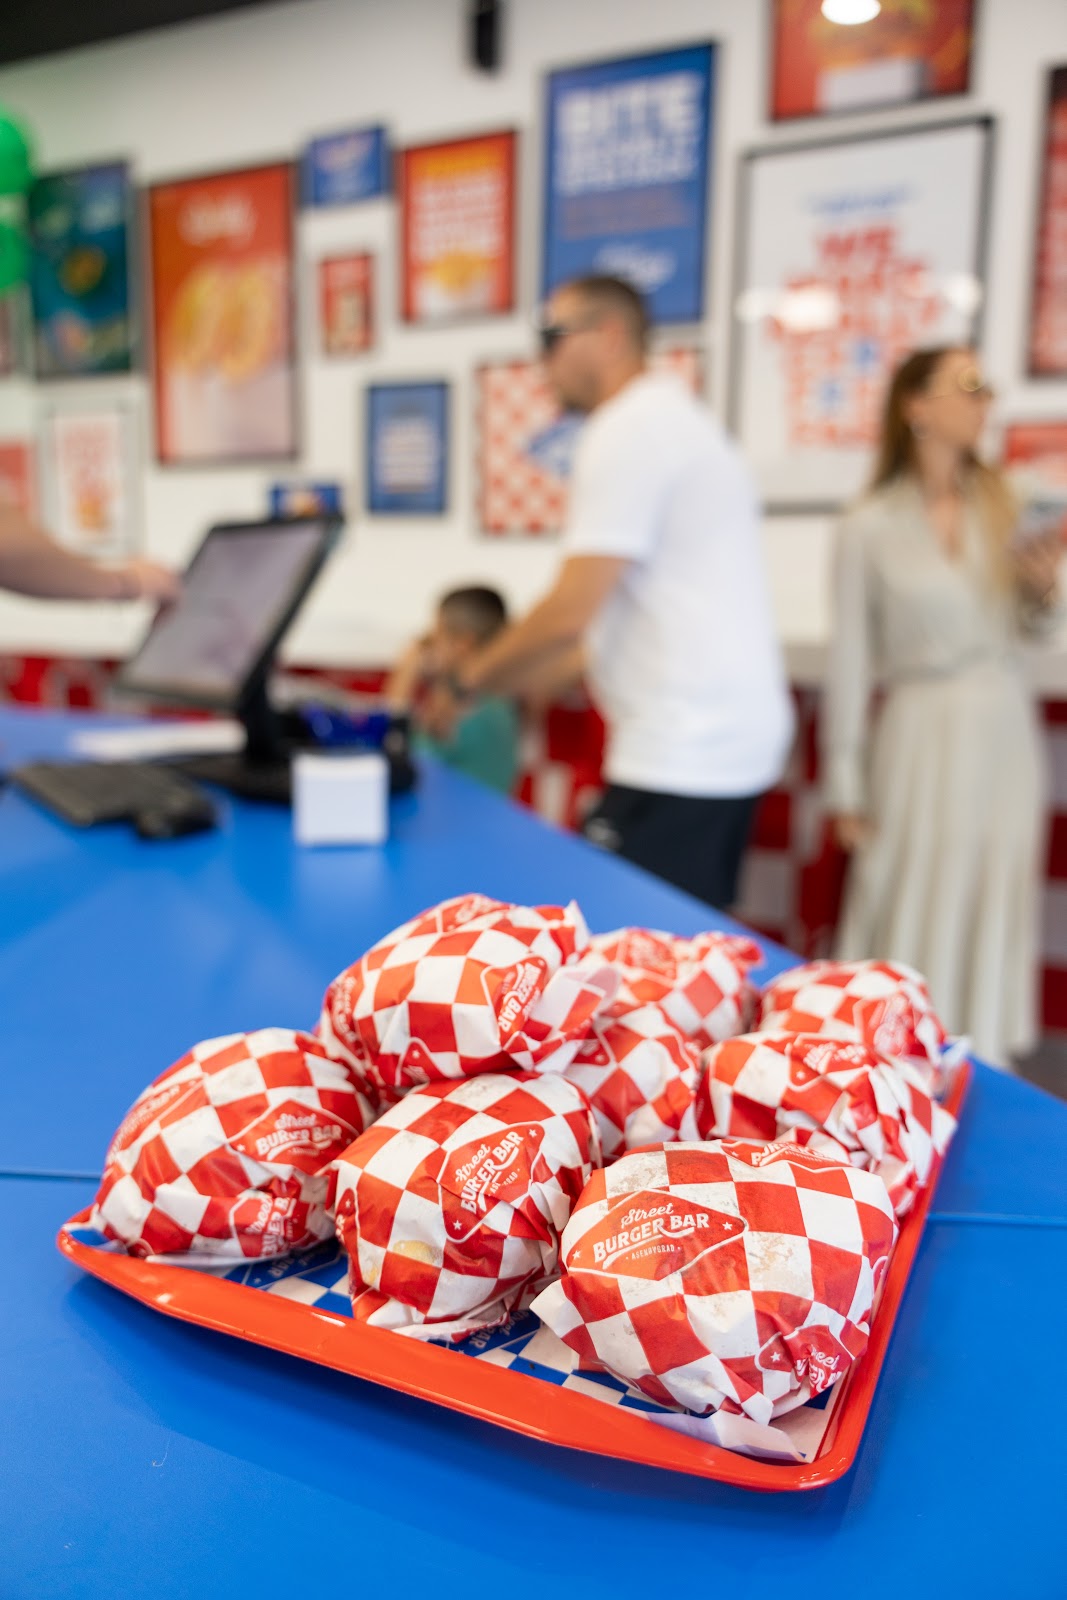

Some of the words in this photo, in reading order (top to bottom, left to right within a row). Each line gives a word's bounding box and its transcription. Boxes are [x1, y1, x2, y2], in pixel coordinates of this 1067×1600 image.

[498, 997, 522, 1033] BAR
[312, 1124, 342, 1143] BAR
[492, 1131, 524, 1163] BAR
[455, 1143, 491, 1183] Street
[620, 1202, 674, 1230] Street
[592, 1217, 666, 1264] BURGER
[670, 1212, 709, 1230] BAR
